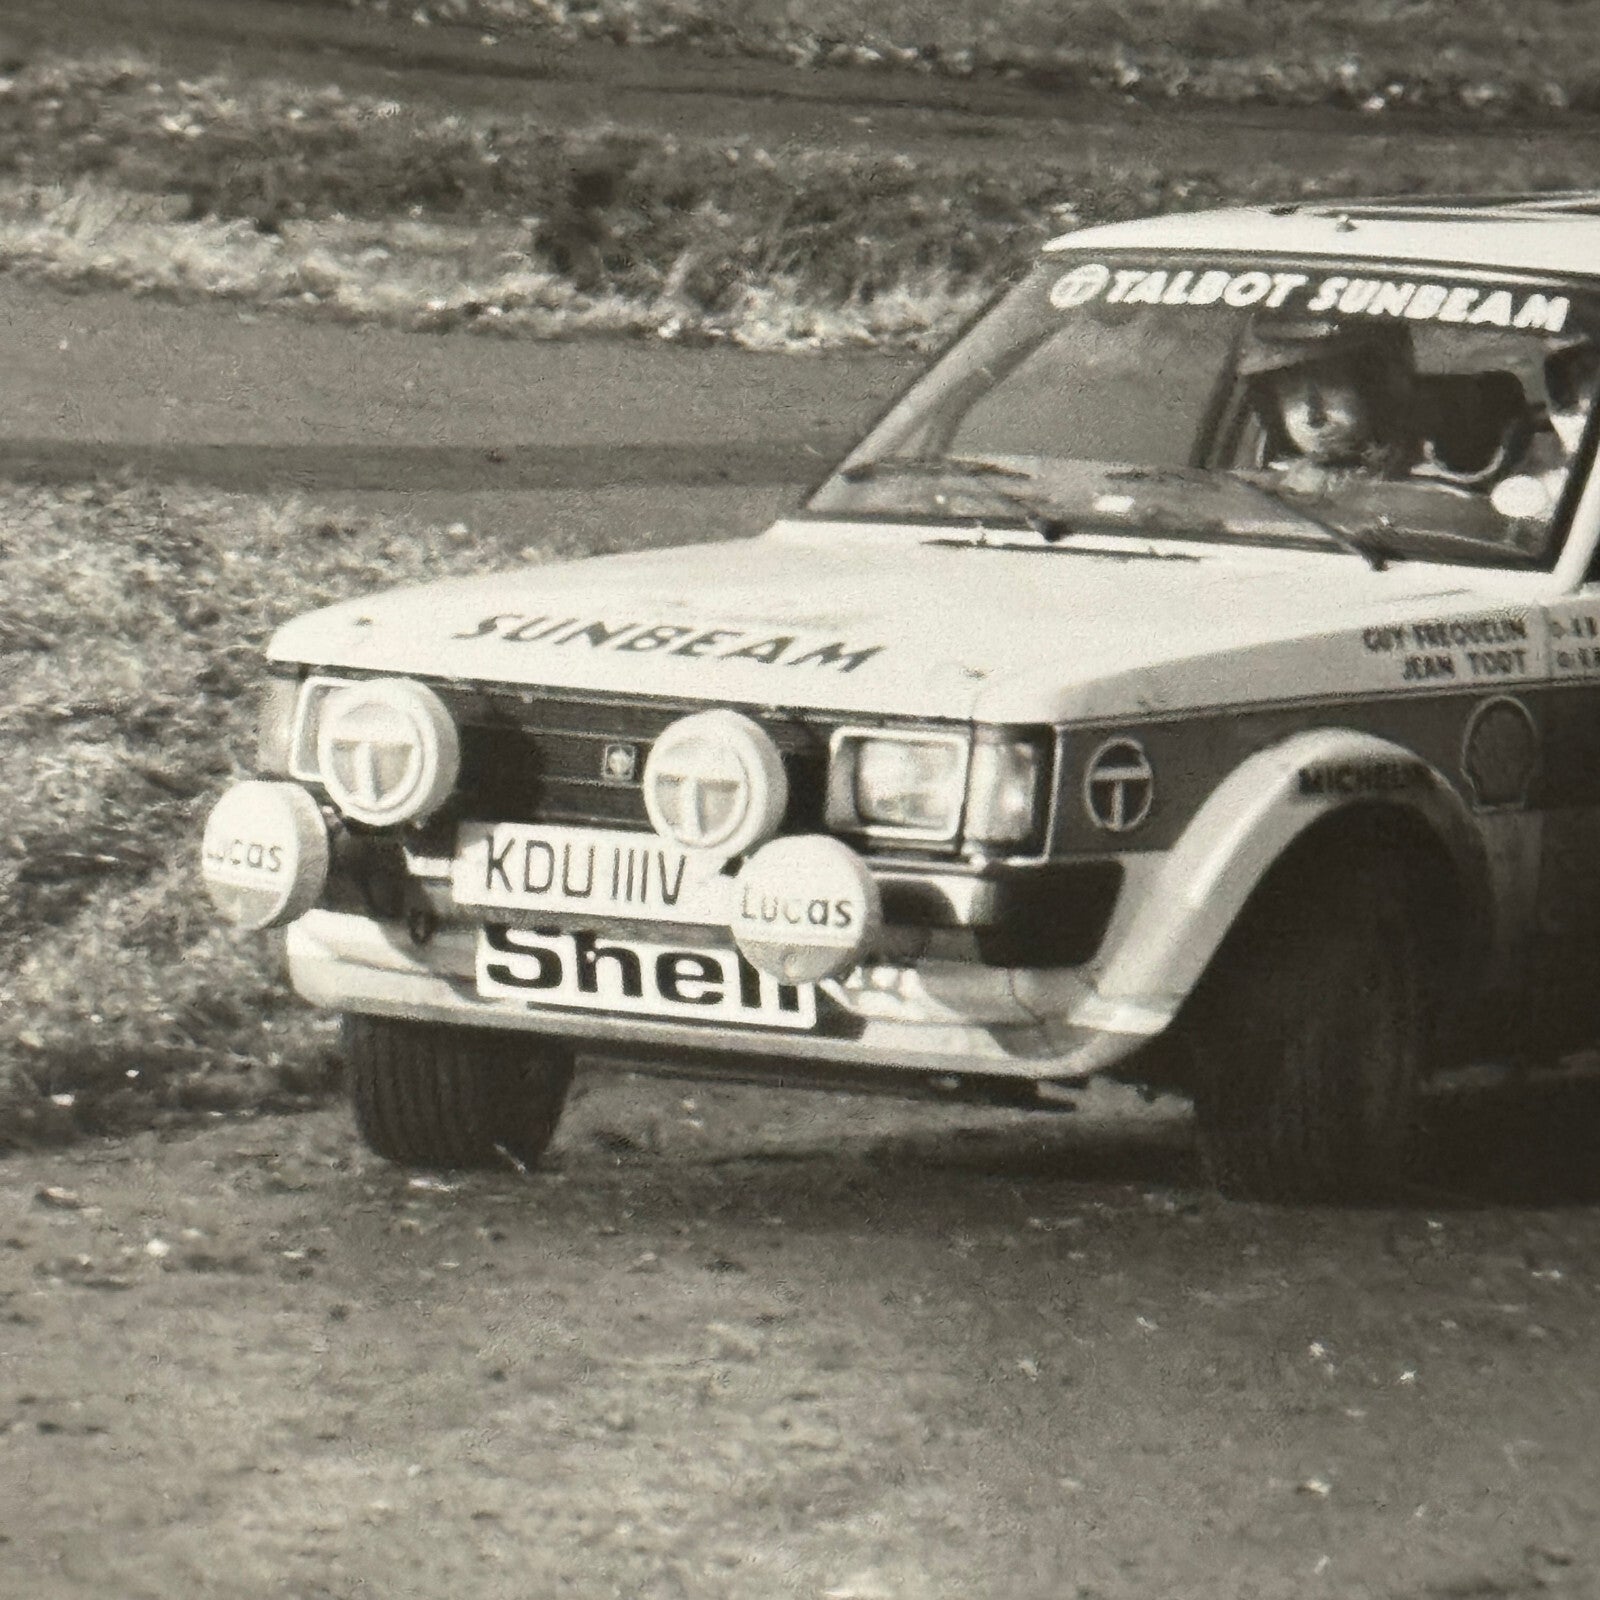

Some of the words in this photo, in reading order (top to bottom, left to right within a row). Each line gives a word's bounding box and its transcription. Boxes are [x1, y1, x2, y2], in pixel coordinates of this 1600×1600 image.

[1105, 270, 1308, 308] TALBOT
[1307, 276, 1570, 333] SUNBEAM
[452, 613, 886, 673] SUNBEAM
[486, 834, 595, 899] KDU
[741, 885, 854, 929] Lucas
